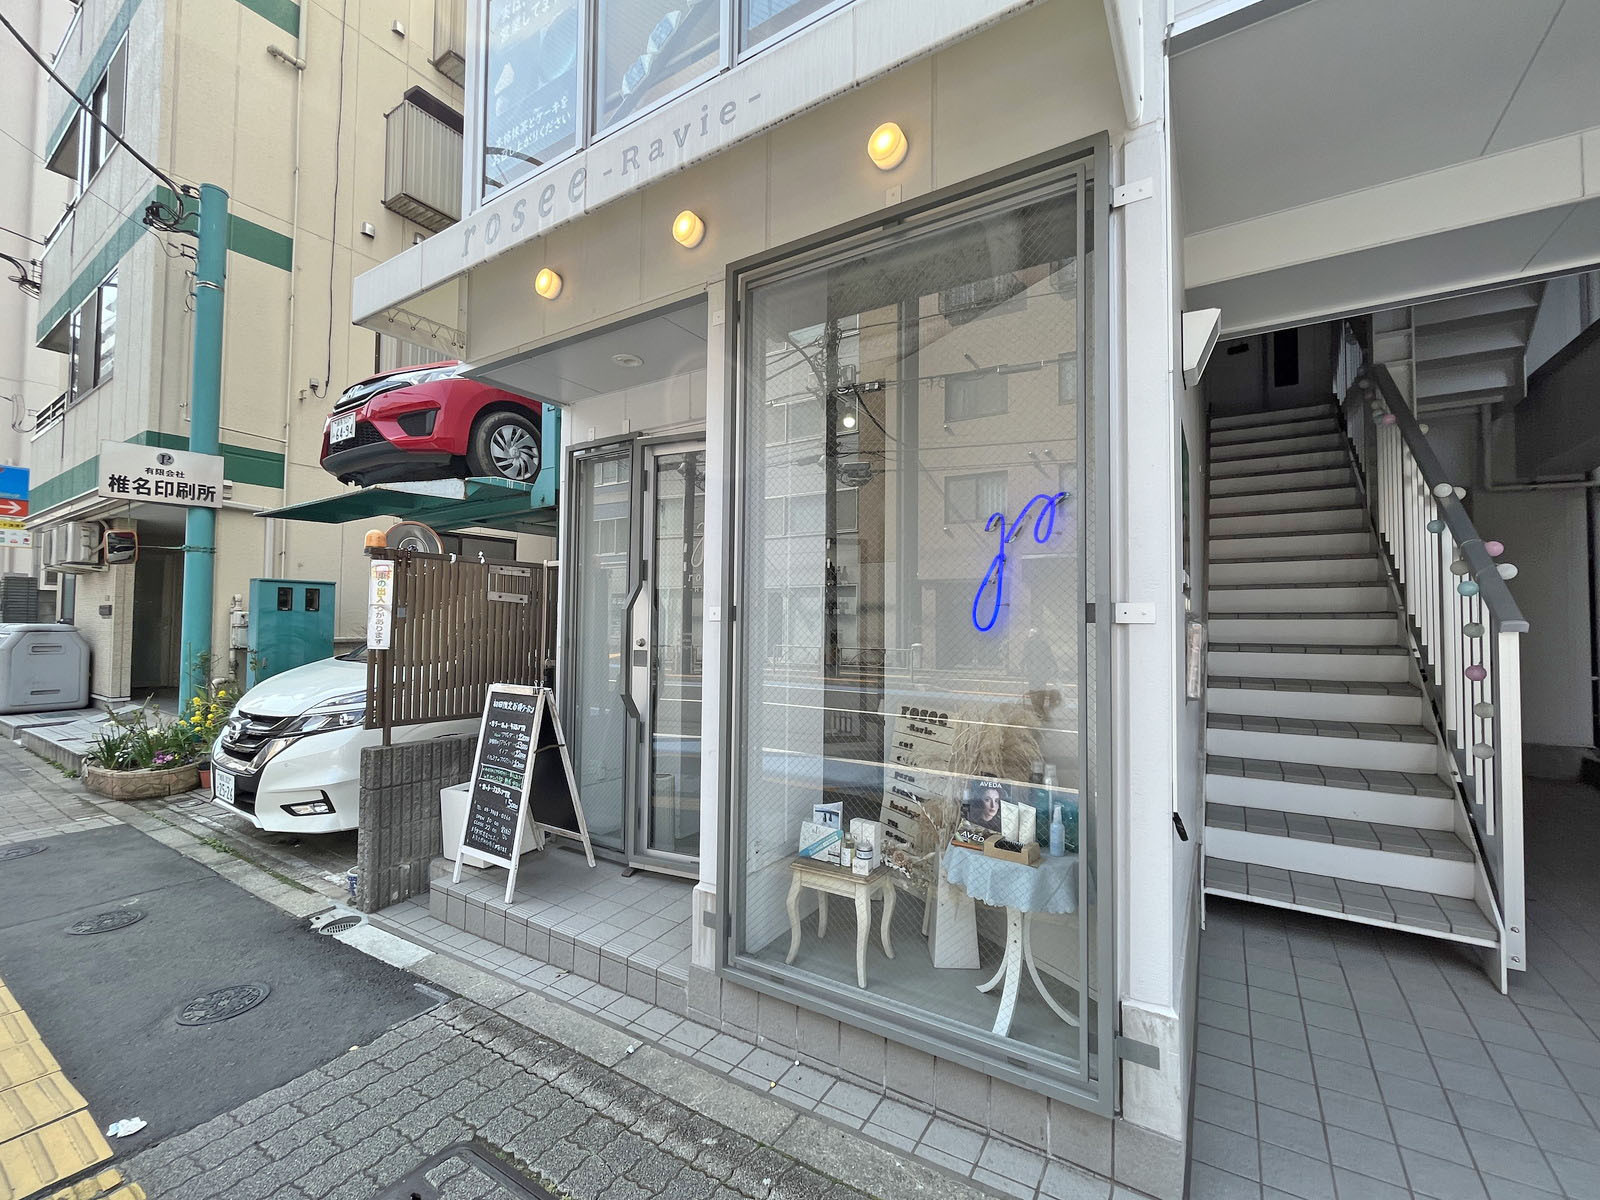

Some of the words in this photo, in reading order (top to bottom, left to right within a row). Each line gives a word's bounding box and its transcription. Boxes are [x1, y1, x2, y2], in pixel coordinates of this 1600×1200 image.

[462, 166, 587, 258] rosee
[145, 467, 185, 479] 有限会社
[108, 474, 217, 502] 椎名印刷所
[979, 781, 1003, 789] AVEDA
